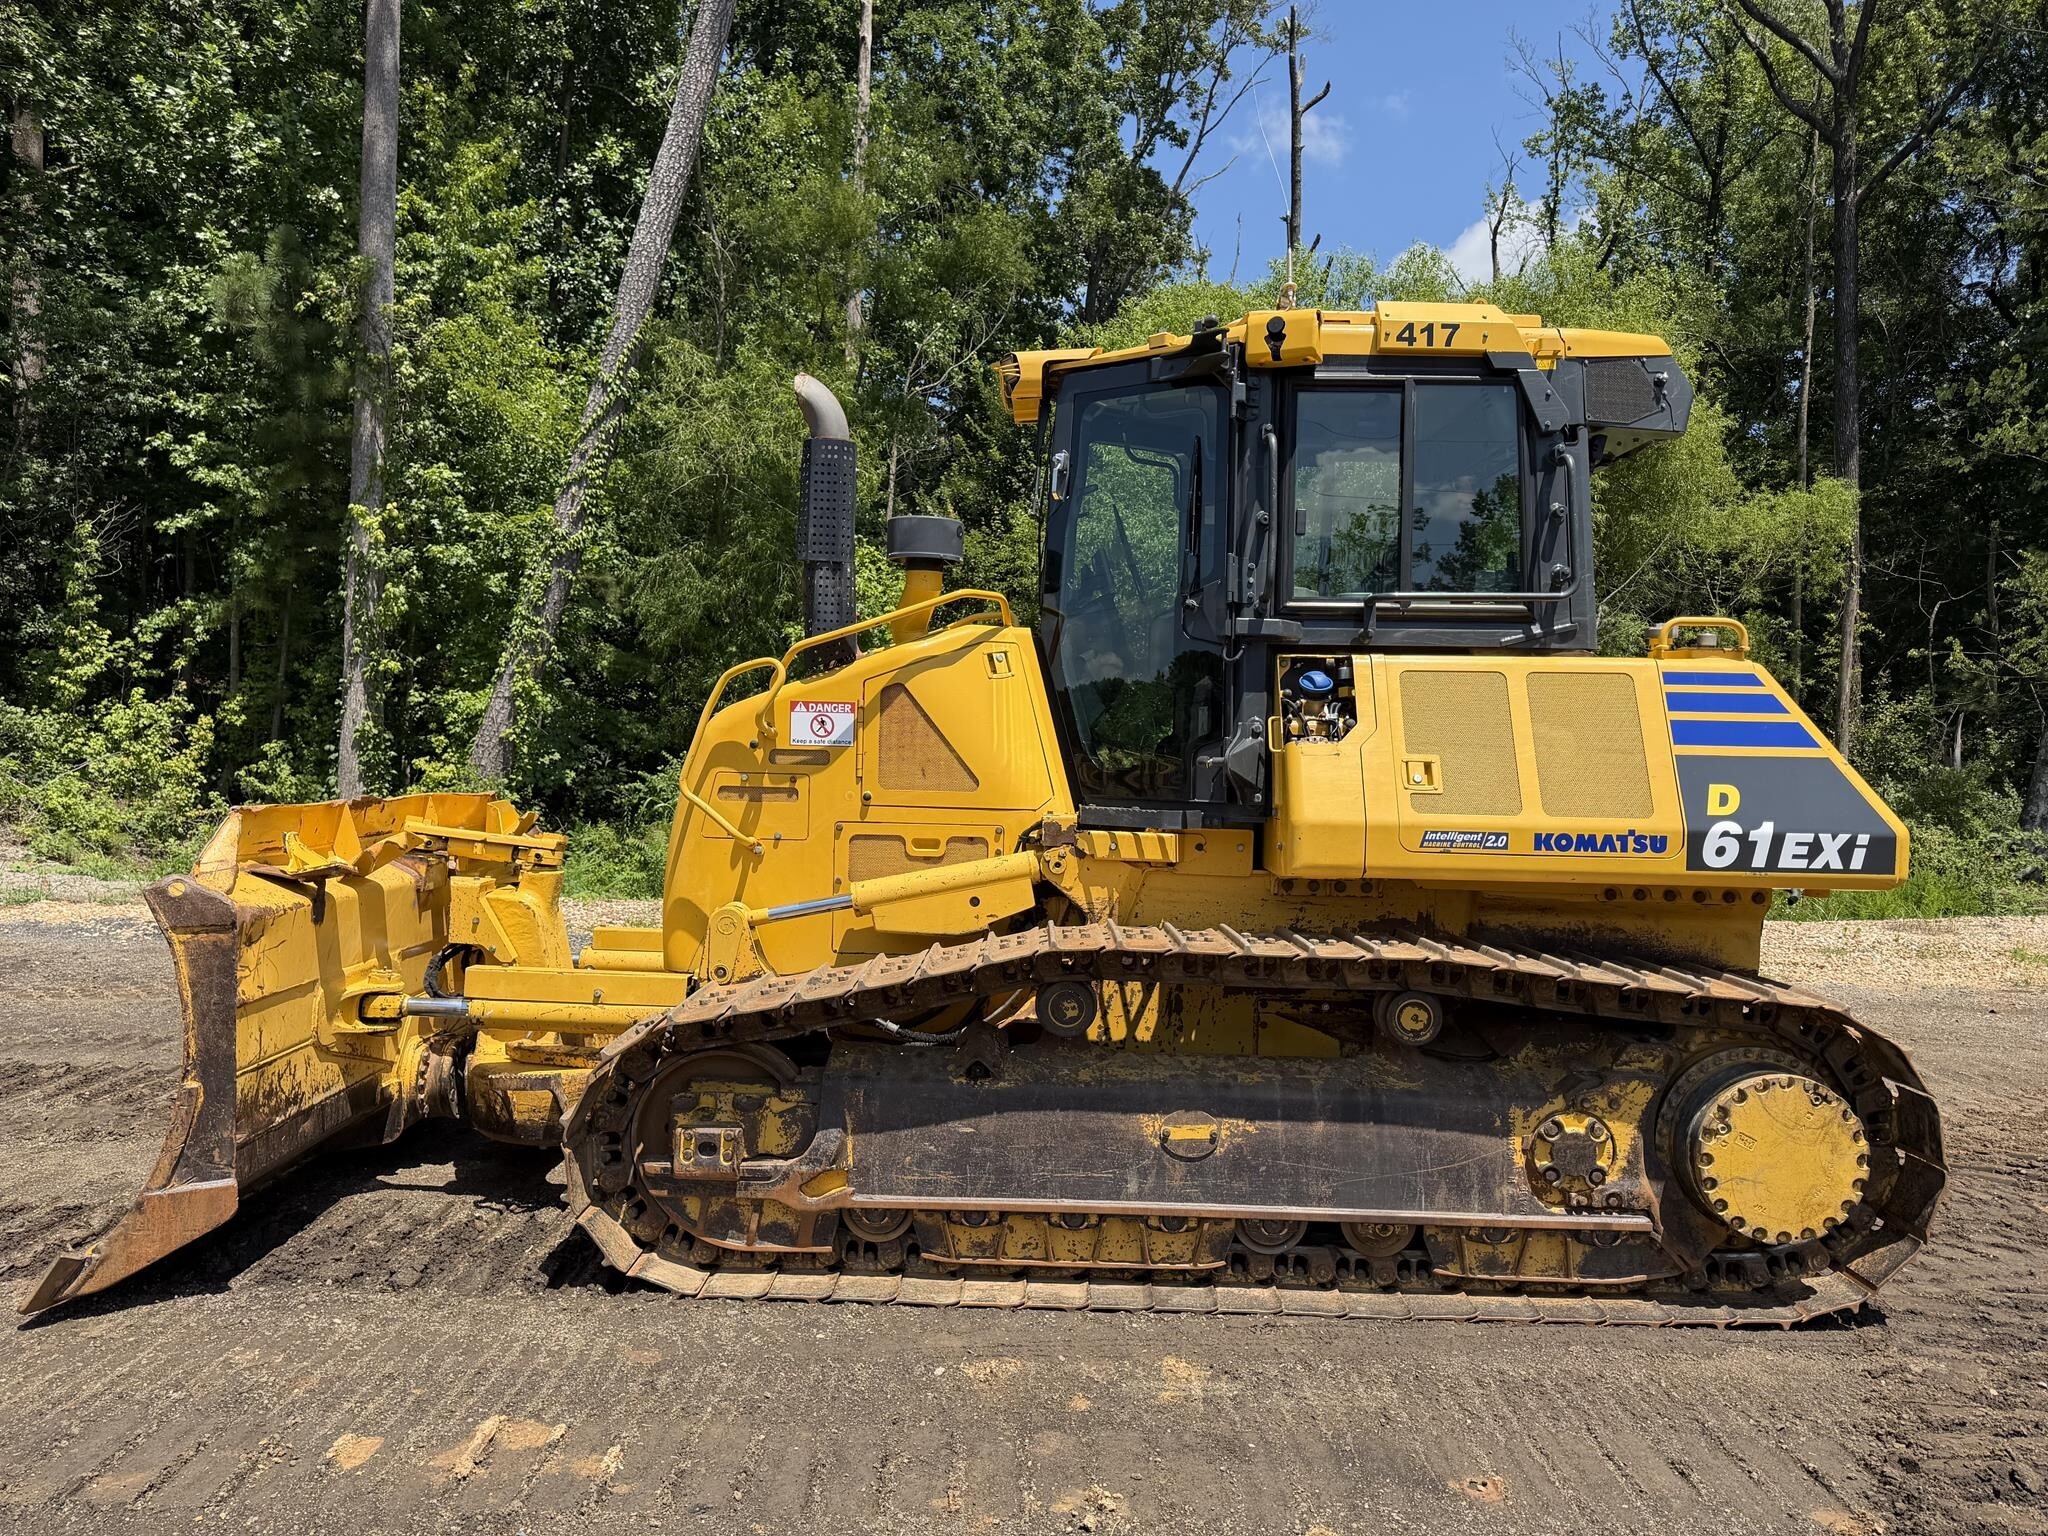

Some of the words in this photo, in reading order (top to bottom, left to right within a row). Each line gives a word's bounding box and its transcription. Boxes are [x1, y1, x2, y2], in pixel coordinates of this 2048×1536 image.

[1396, 322, 1461, 347] 417
[808, 703, 852, 713] DANGER
[1706, 783, 1741, 816] D
[1424, 831, 1483, 842] intelligent
[1485, 835, 1507, 847] 2.0
[1533, 829, 1668, 854] KOMATSU
